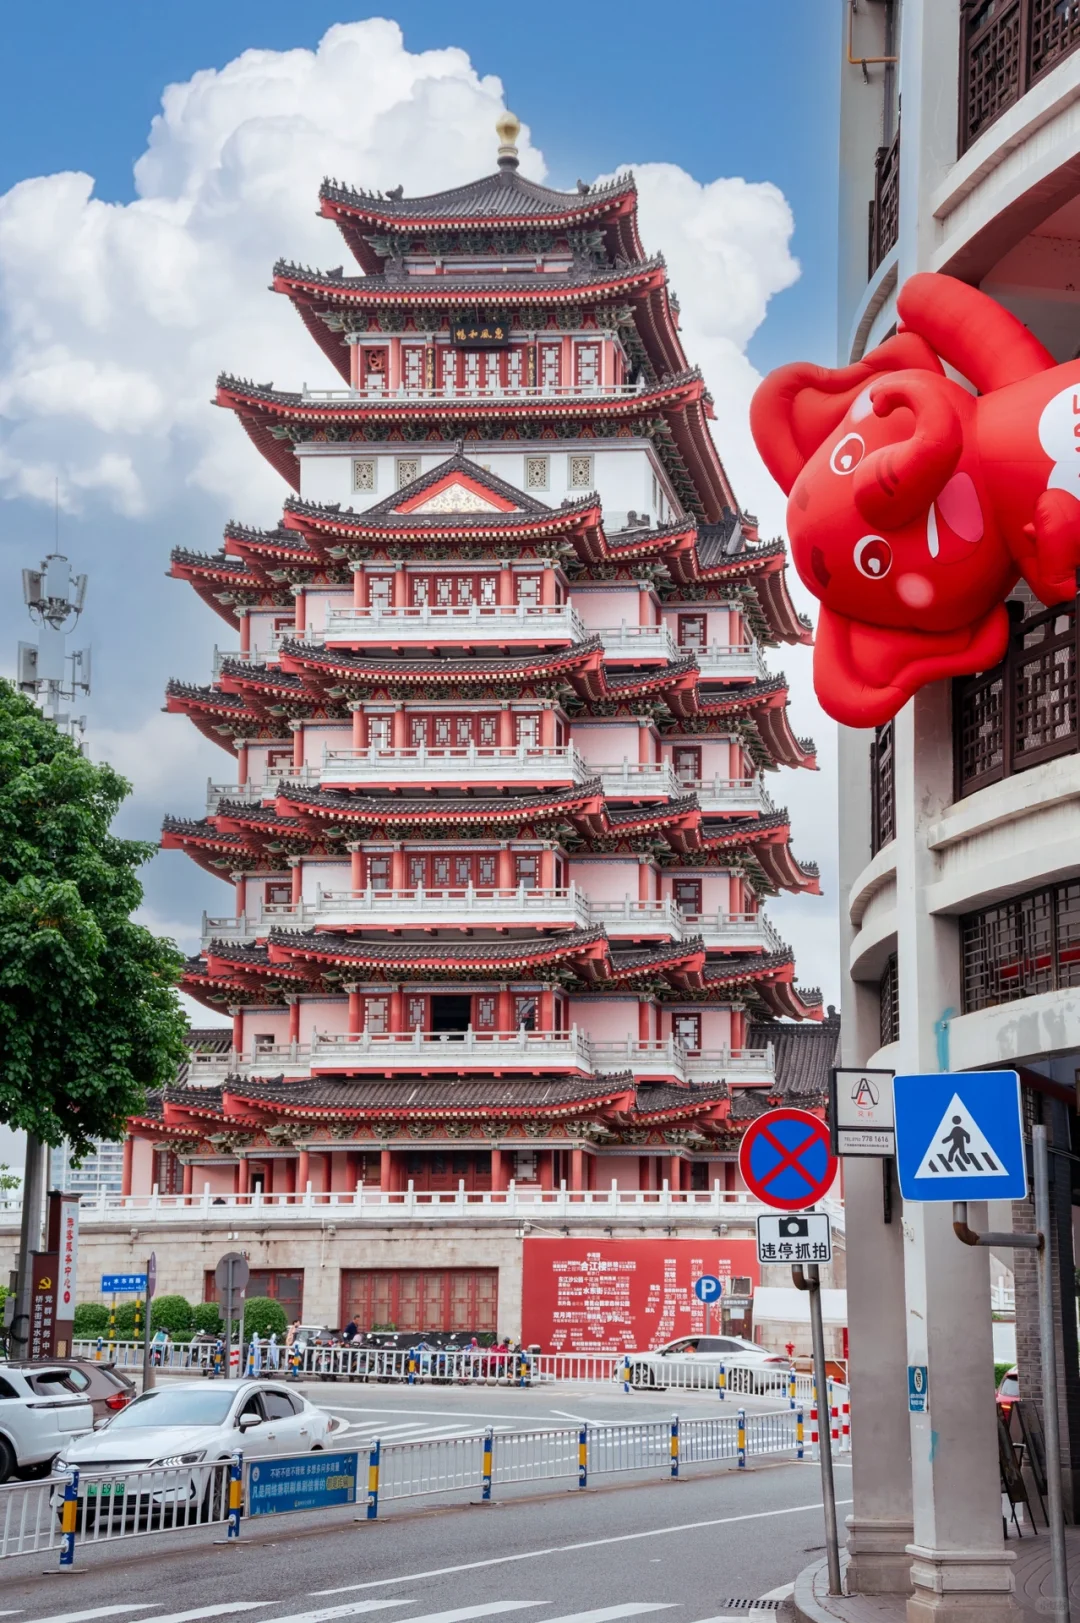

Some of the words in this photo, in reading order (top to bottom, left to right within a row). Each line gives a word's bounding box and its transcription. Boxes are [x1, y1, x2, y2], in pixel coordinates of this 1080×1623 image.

[762, 1243, 828, 1260] 违停抓拍
[580, 1261, 607, 1271] 合江楼
[583, 1287, 603, 1295] 水东街
[701, 1279, 716, 1299] P
